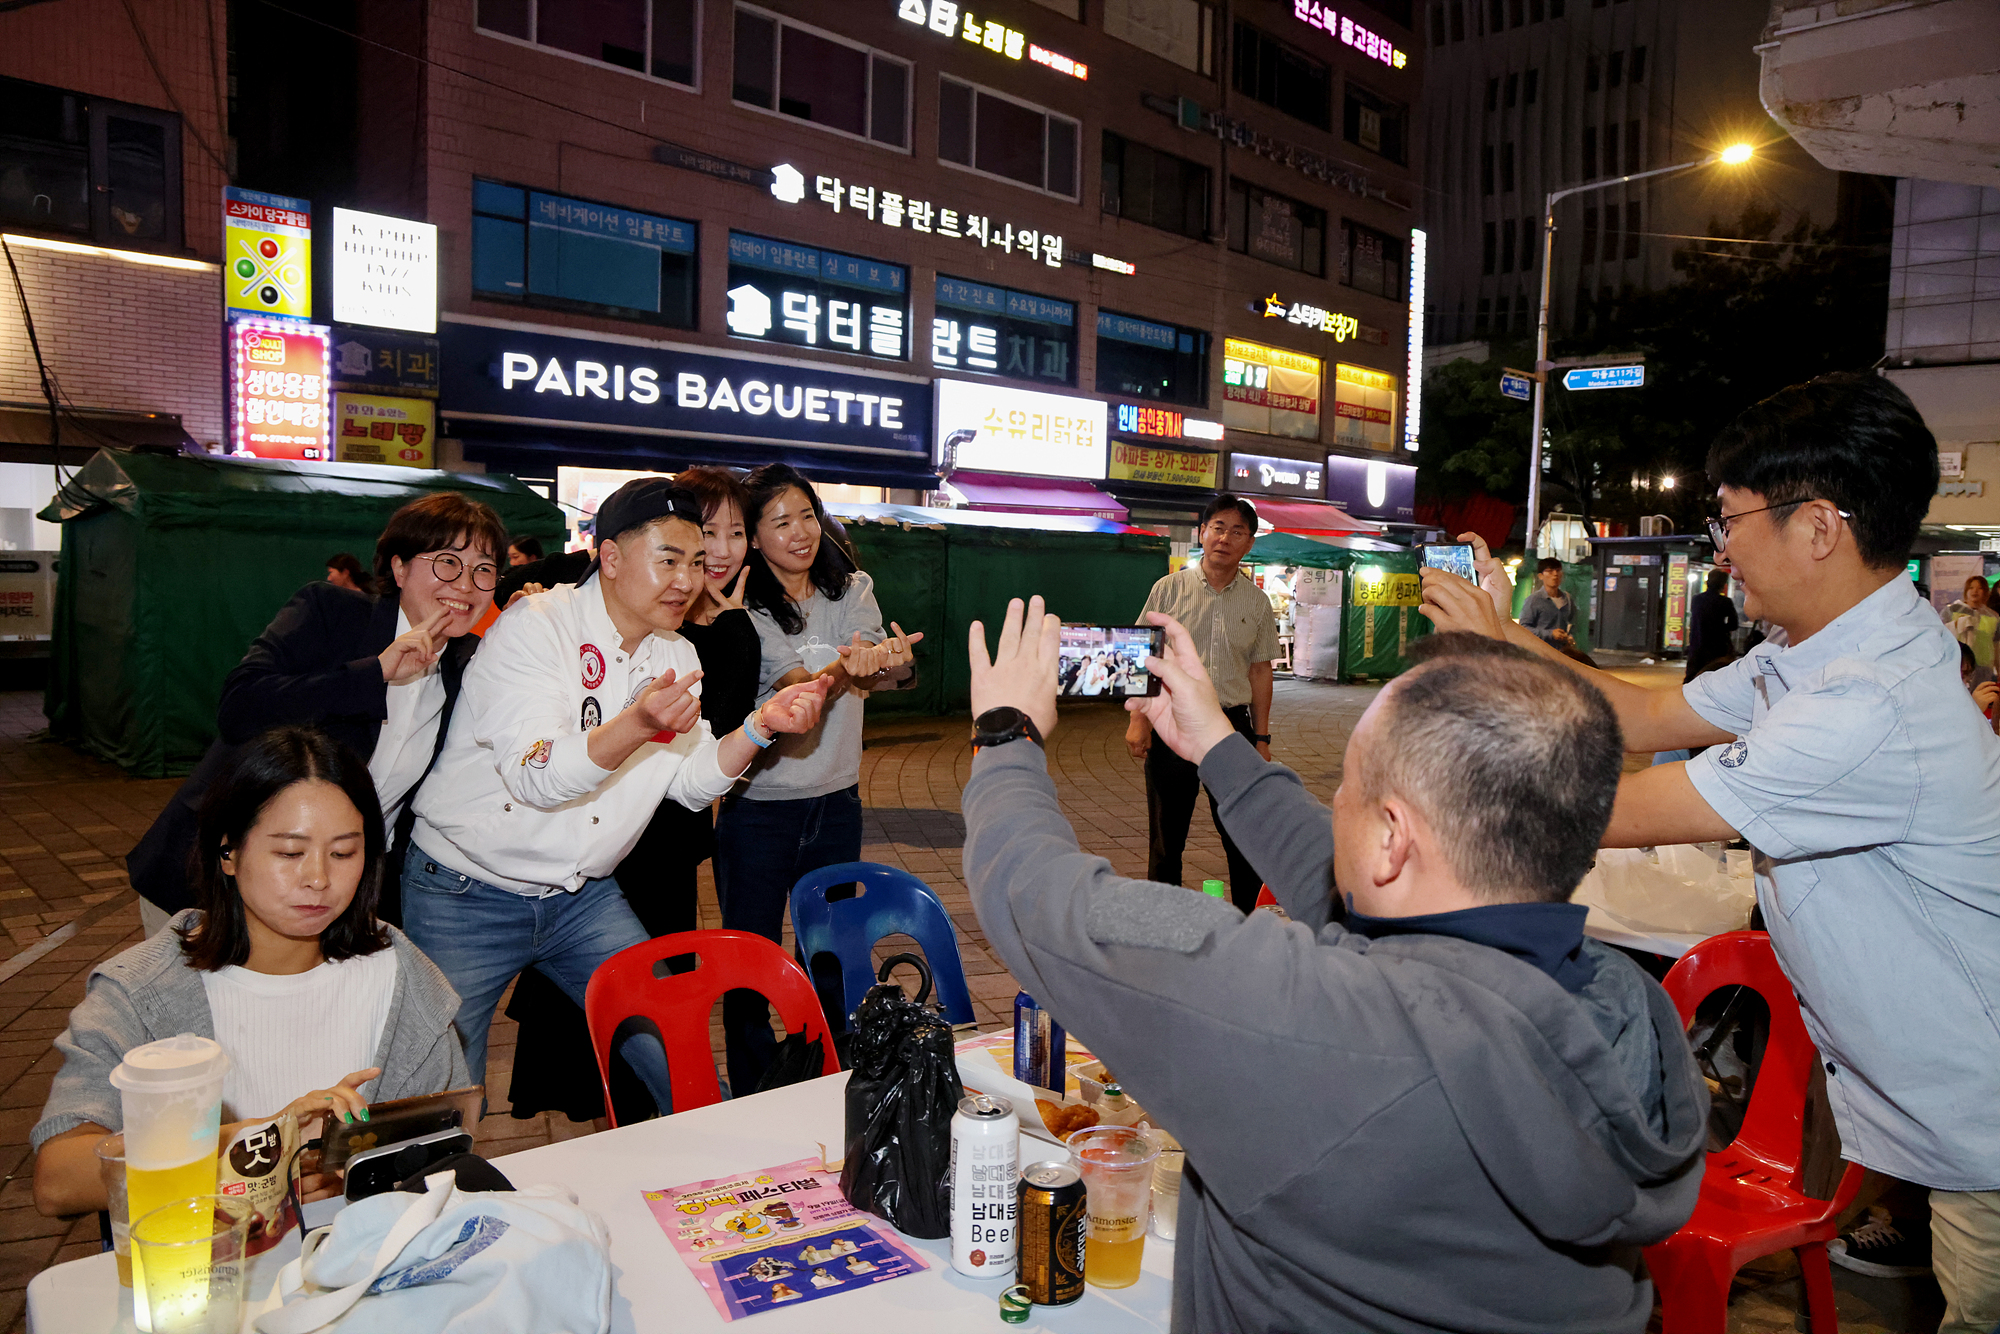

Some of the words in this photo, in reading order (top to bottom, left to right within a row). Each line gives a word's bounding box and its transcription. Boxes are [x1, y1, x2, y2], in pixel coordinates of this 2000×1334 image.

[962, 12, 1025, 60] 노래방
[230, 203, 264, 220] 스카이
[264, 208, 307, 227] 당구클럽
[540, 201, 619, 233] 네비게이션
[626, 217, 685, 243] 임플란트
[729, 237, 766, 261] 원데이
[770, 246, 818, 270] 임플란트
[1009, 296, 1037, 316] 수요일
[1040, 302, 1072, 322] 9시까지
[1288, 302, 1358, 343] 스타키보청기
[252, 349, 283, 362] SHOP
[378, 349, 434, 381] 치과
[1006, 334, 1070, 382] 치과
[244, 369, 321, 400] 성인용품
[502, 352, 661, 405] PARIS
[677, 372, 904, 430] BAGUETTE
[245, 397, 322, 428] 할인매장
[983, 407, 1094, 448] 수유리닭집
[341, 418, 427, 447] 노래방
[304, 449, 320, 459] B1
[404, 450, 419, 460] B1
[736, 1176, 823, 1204] 페스티벌
[972, 1202, 1018, 1220] 남대문
[1086, 1212, 1138, 1227] Artmonster
